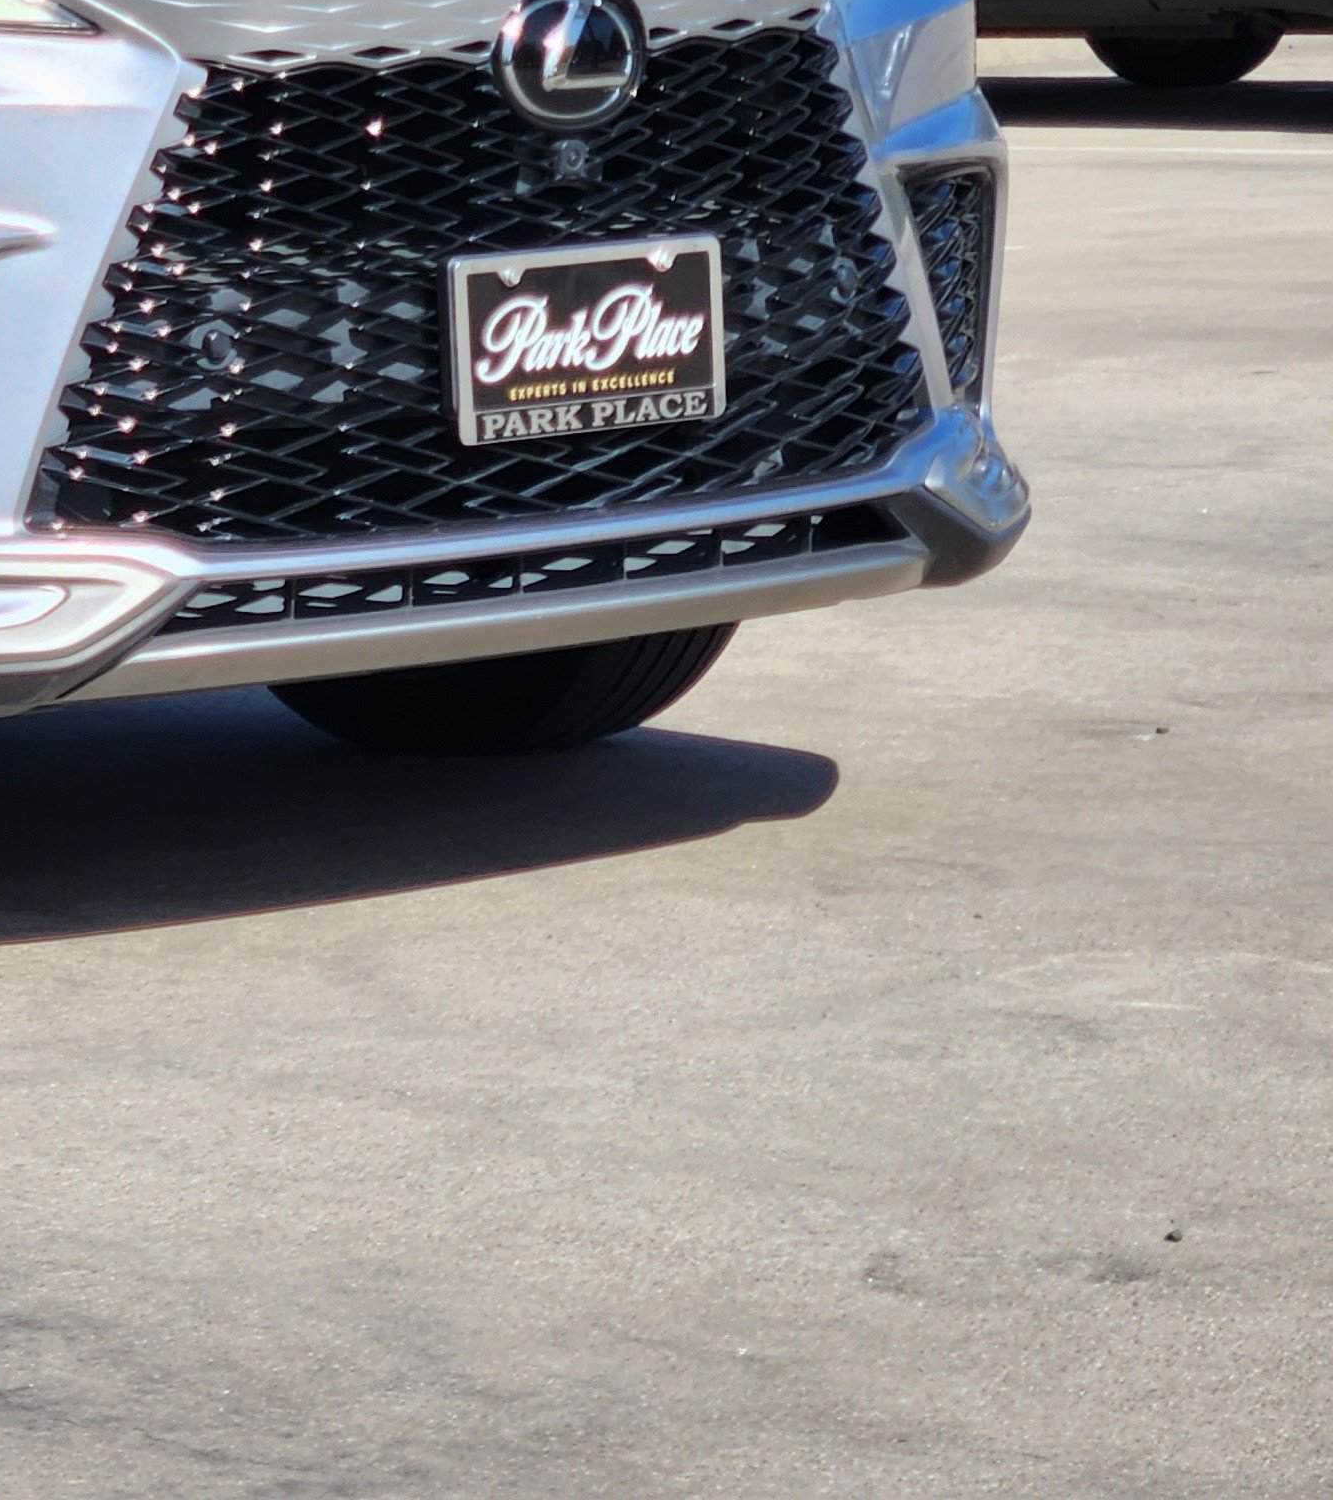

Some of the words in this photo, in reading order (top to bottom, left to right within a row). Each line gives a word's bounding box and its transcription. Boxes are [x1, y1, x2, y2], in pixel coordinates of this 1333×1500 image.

[475, 294, 593, 384] Park
[583, 283, 703, 371] Place
[509, 382, 567, 401] EXPERTS
[572, 379, 587, 394] IN
[592, 370, 675, 392] EXCELLENCE
[483, 403, 584, 440] PARK
[591, 391, 708, 428] PLACE
